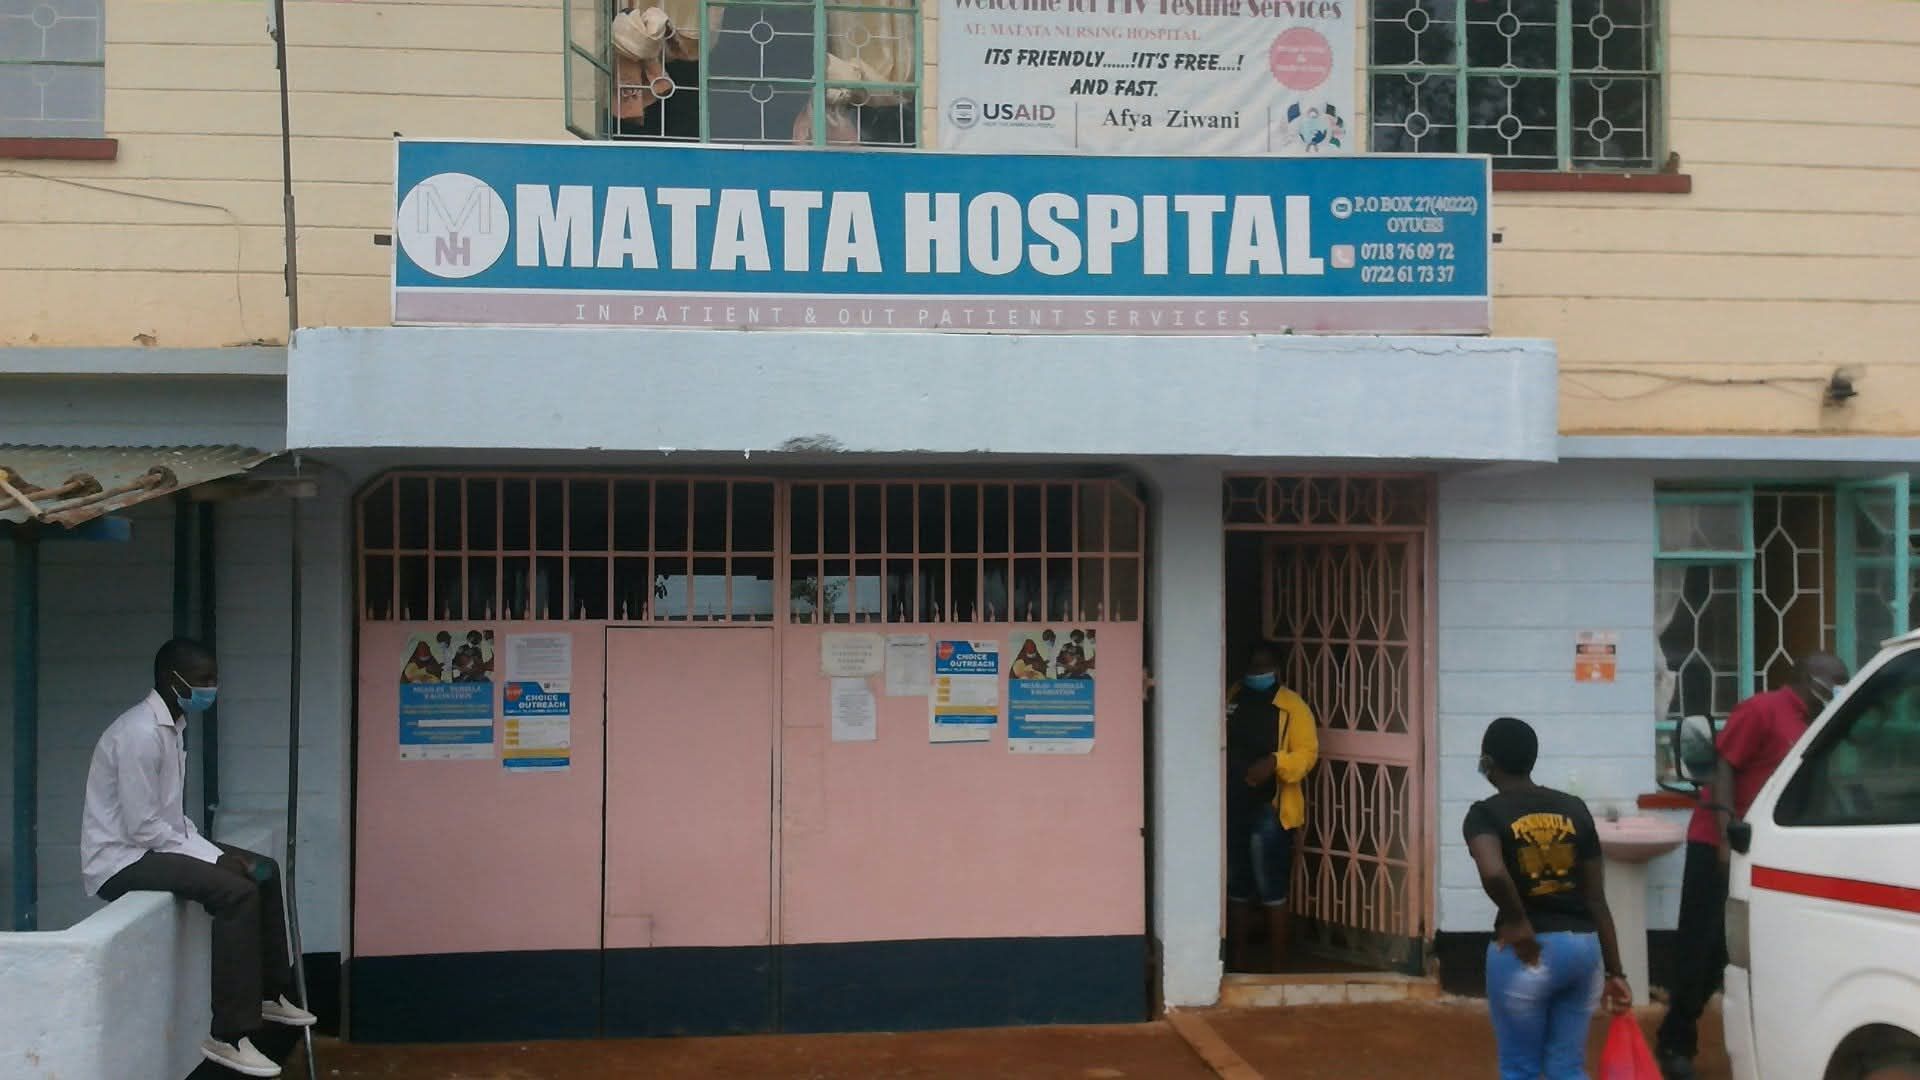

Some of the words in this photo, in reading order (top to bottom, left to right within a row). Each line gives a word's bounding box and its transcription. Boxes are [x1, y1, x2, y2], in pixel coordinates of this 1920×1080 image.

[1248, 0, 1343, 19] Services
[1055, 26, 1122, 39] NURSING
[1126, 27, 1200, 41] HOSPITAL
[984, 48, 1012, 66] ITS
[1070, 79, 1108, 96] AND
[1114, 80, 1159, 97] FAST.
[983, 103, 1056, 121] USAID
[1102, 109, 1153, 131] Afya
[1166, 109, 1240, 129] Ziwani
[1353, 196, 1379, 212] P.O
[1381, 197, 1413, 212] BOX
[515, 183, 884, 273] MATATA
[904, 191, 1325, 276] HOSPITAL
[1361, 243, 1394, 260] 0718
[1398, 243, 1415, 260] 76
[1416, 243, 1434, 260] 09
[1437, 243, 1455, 260] 72
[1361, 266, 1394, 283] 0722
[1397, 266, 1414, 283] 61
[1417, 266, 1434, 283] 73
[1437, 266, 1455, 283] 37
[575, 304, 610, 321] IN
[633, 305, 783, 324] PATIENT
[804, 308, 817, 323] &
[838, 308, 896, 326] OUT
[918, 309, 1063, 327] PATIENT
[1084, 310, 1250, 327] SERVICES
[518, 701, 566, 709] OUTREACH
